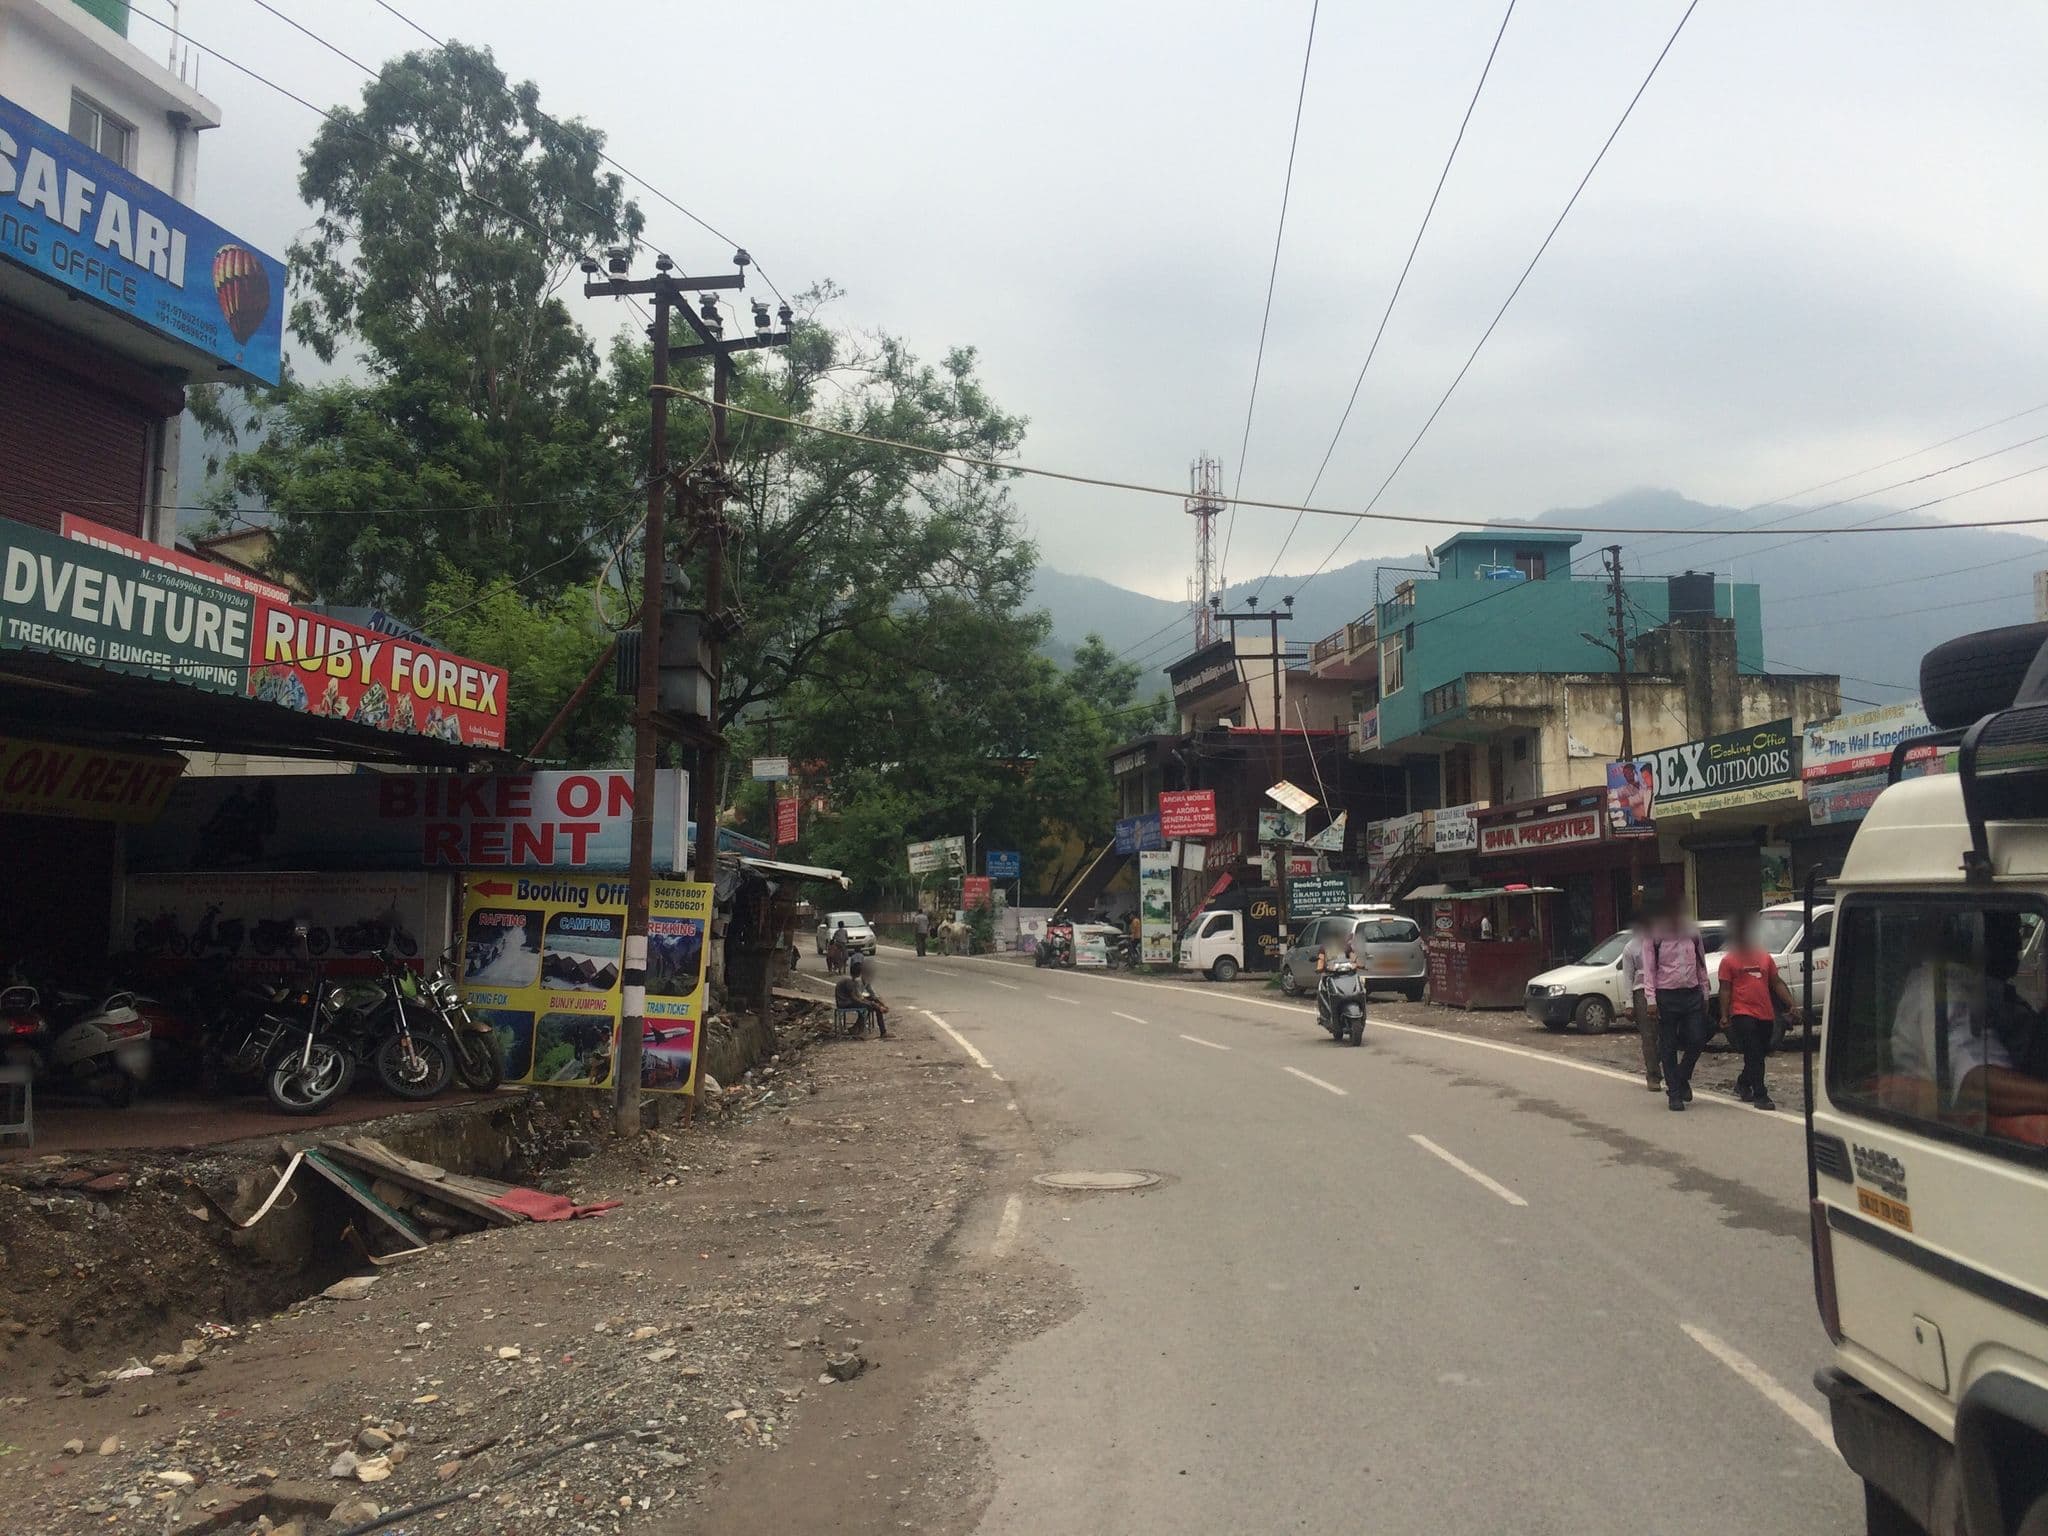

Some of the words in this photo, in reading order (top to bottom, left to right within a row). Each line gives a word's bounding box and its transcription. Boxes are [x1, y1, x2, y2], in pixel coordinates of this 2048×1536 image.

[52, 239, 138, 306] OFFICE
[3, 545, 248, 659] DVENTURE
[8, 617, 97, 655] TREKKING
[109, 642, 171, 673] BUNGEE
[174, 657, 239, 688] JUMPING
[264, 607, 384, 686] RUBY
[391, 645, 500, 716] FOREX
[1708, 740, 1753, 760] Booking
[1753, 732, 1787, 748] Office
[1828, 740, 1847, 756] The
[1848, 733, 1870, 752] Wall
[4, 747, 75, 797] ON
[65, 755, 181, 806] RENT
[1706, 749, 1790, 788] OUTDOORS
[379, 775, 533, 818] BIKE
[1162, 815, 1192, 824] GENERAL
[1193, 813, 1215, 822] STORE
[423, 822, 600, 866] RENT
[517, 879, 589, 908] Booking
[596, 882, 630, 906] Offi
[655, 886, 707, 899] 9467618097
[1293, 881, 1321, 890] Booking
[653, 900, 706, 912] 9756506201
[479, 913, 527, 928] RAFTING
[559, 916, 611, 932] CAMPING
[648, 921, 697, 937] REKKING
[492, 994, 508, 1006] FOX
[573, 998, 608, 1011] JUMPING
[647, 1001, 664, 1014] TRAIN
[665, 1003, 691, 1015] TICKET
